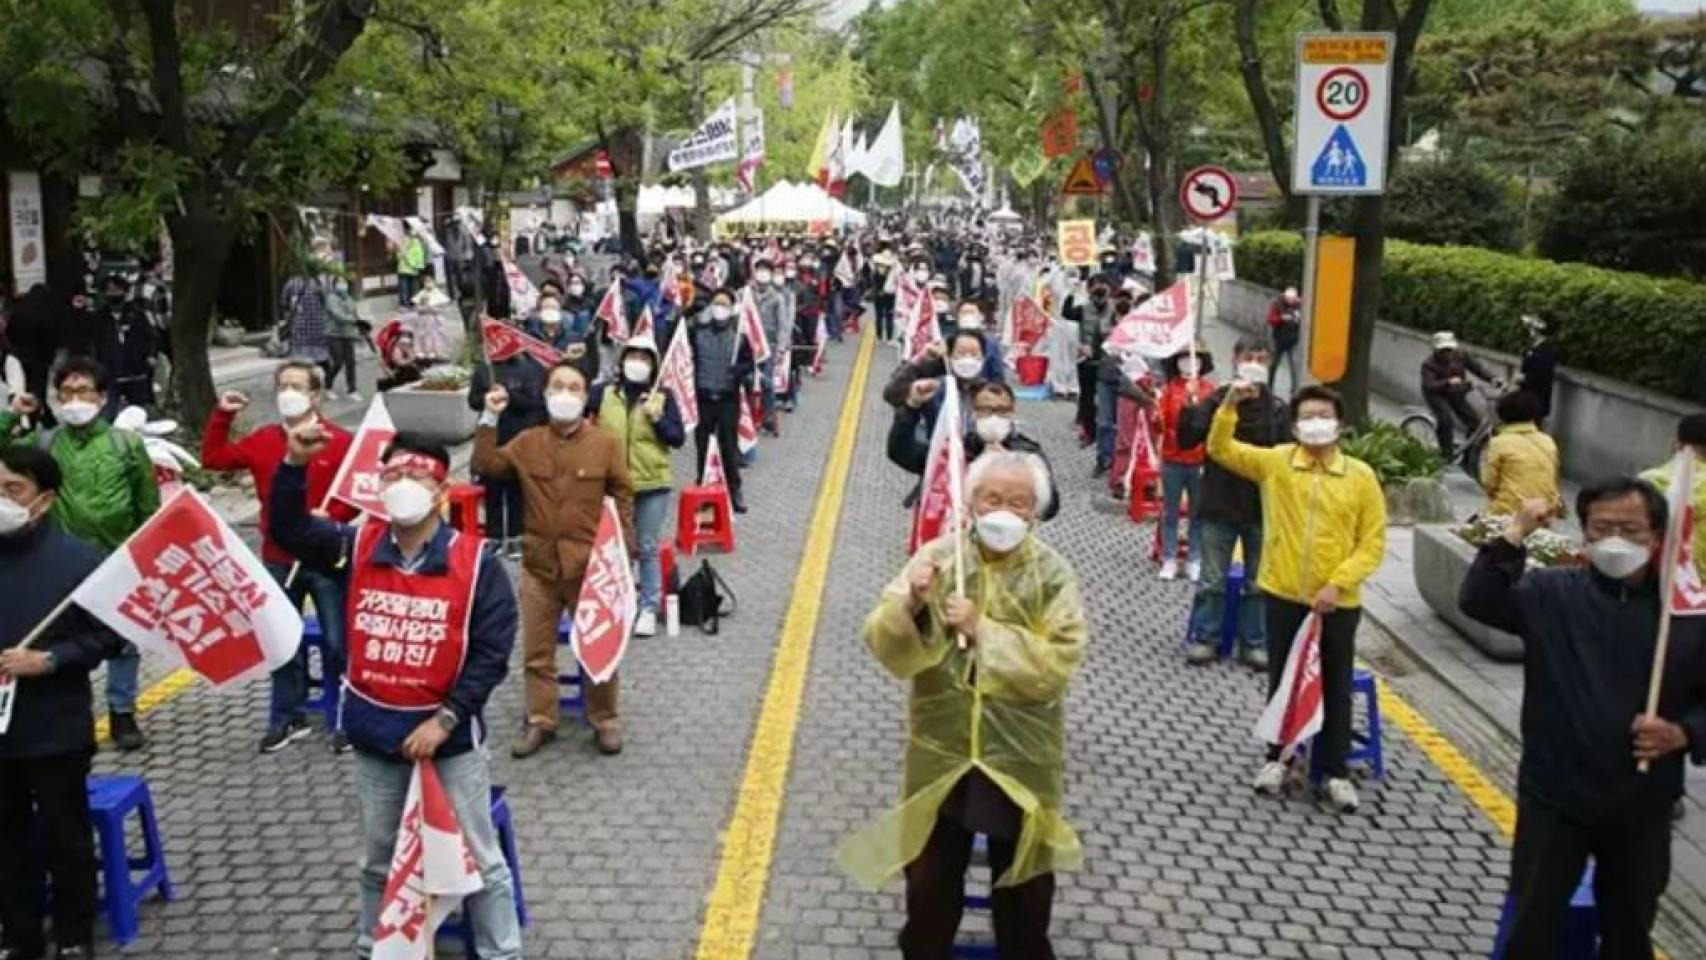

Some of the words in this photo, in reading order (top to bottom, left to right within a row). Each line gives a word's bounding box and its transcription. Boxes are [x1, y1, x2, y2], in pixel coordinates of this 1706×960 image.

[1327, 81, 1360, 105] 20
[1063, 223, 1092, 263] 공
[190, 535, 269, 610] 부동산
[116, 576, 228, 654] 환수!
[352, 611, 450, 644] 악질사업주
[365, 638, 438, 667] 송하진!
